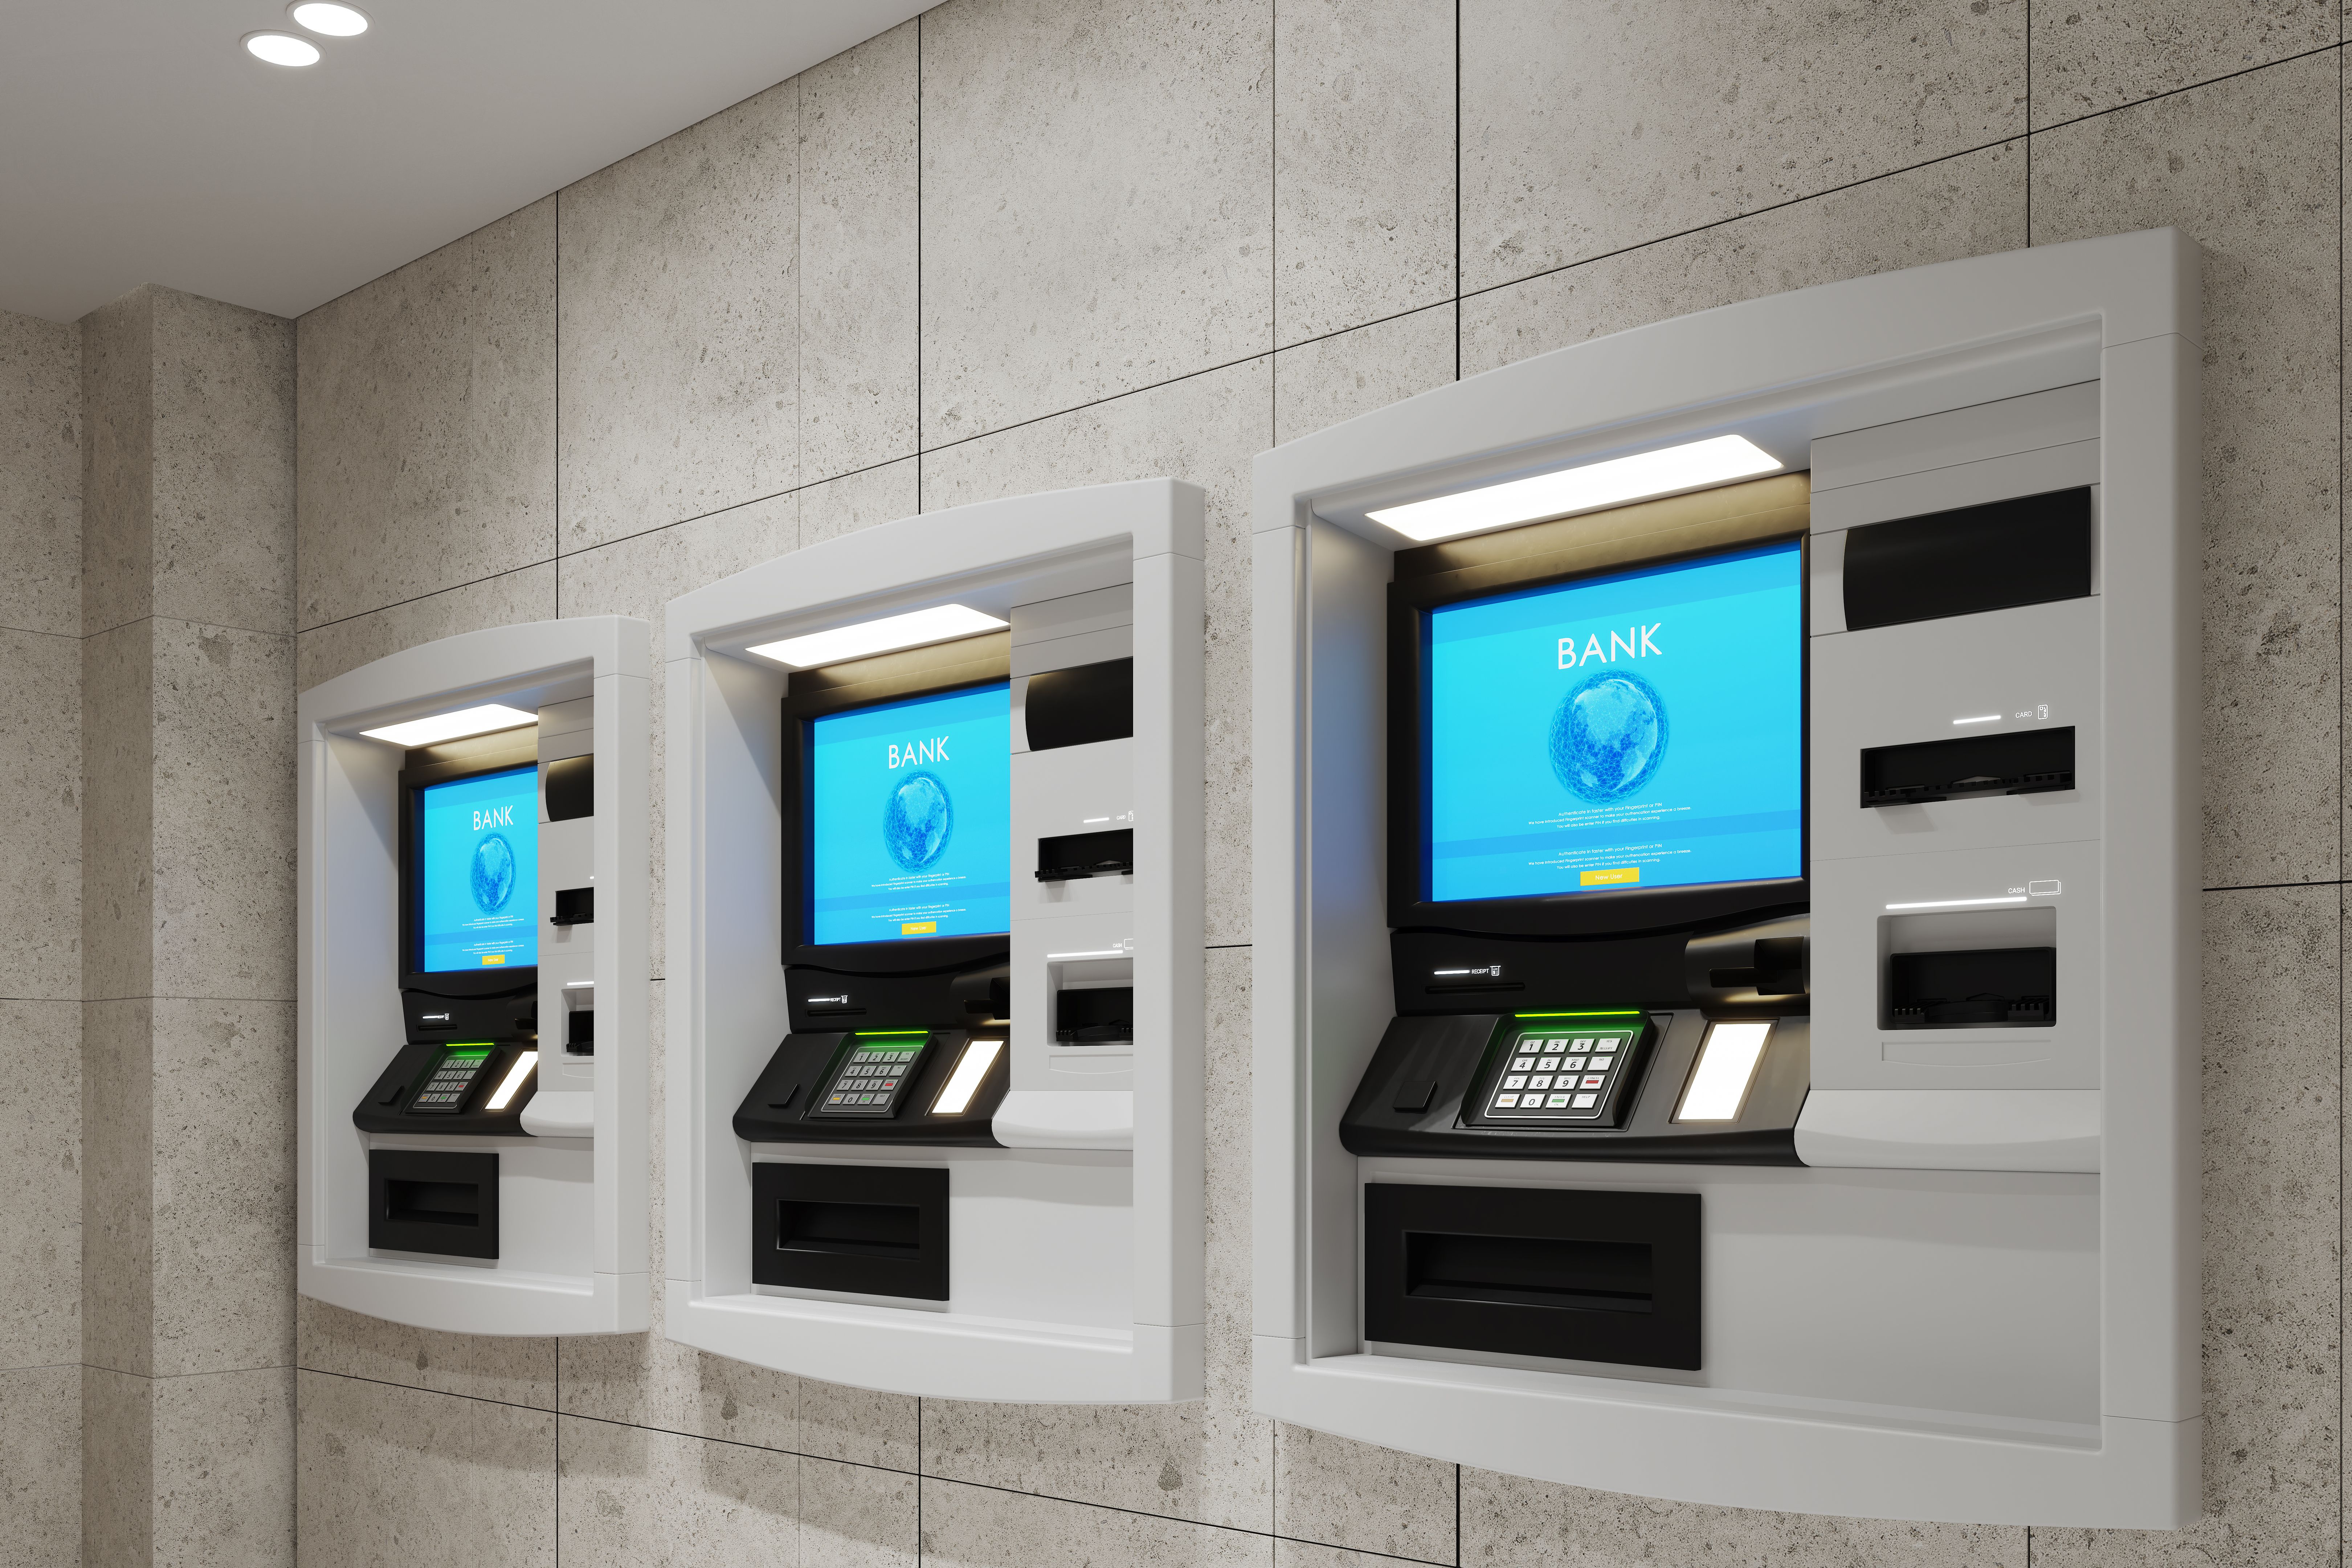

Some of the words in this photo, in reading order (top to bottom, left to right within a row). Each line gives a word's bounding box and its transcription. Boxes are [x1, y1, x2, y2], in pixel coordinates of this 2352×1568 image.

[1558, 622, 1662, 670] BANK
[889, 736, 950, 769] BANK
[473, 805, 514, 831] BANK
